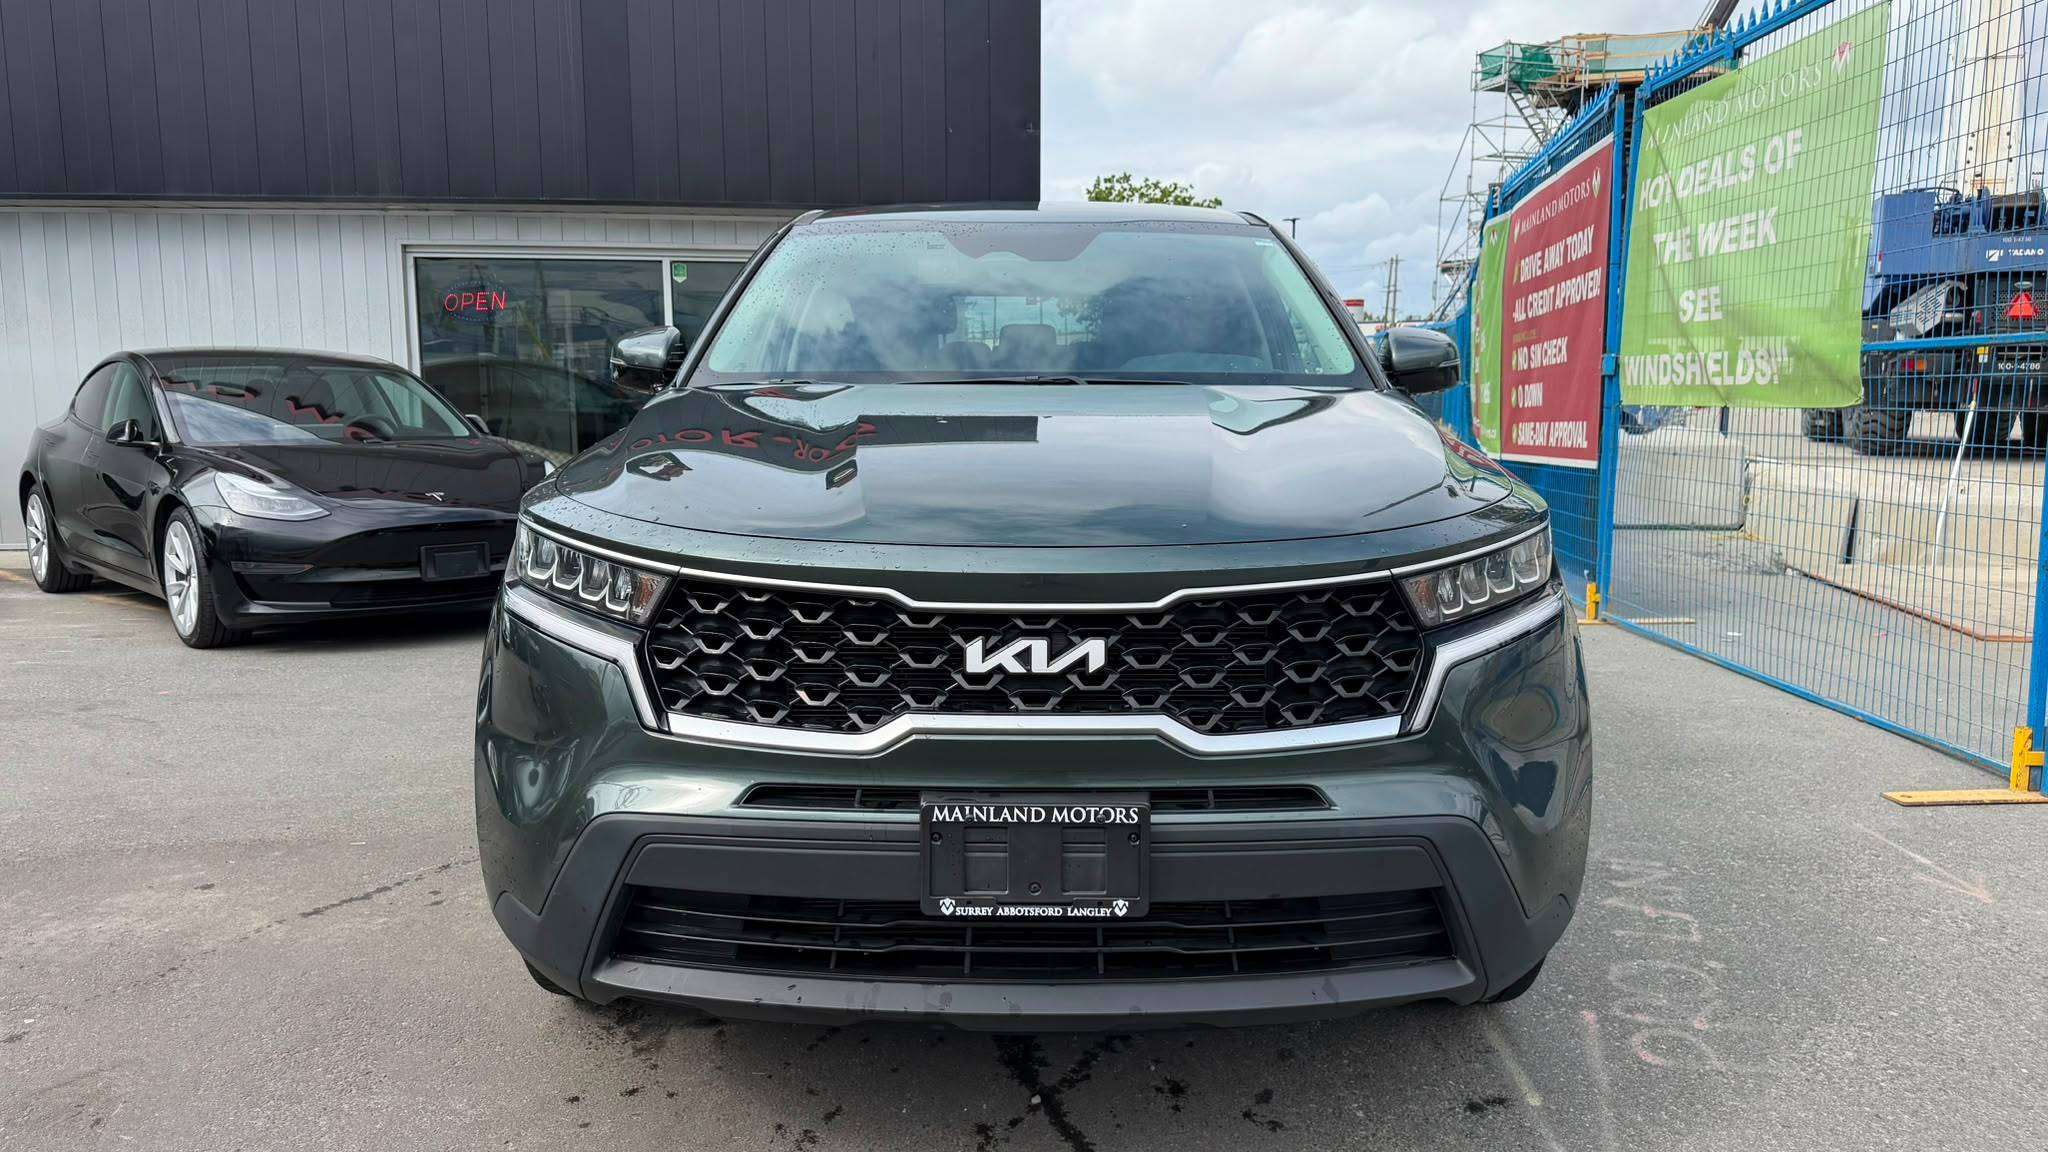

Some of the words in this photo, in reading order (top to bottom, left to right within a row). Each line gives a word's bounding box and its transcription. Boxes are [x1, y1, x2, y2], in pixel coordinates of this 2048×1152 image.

[1676, 143, 1756, 198] DEALS
[1764, 128, 1803, 175] OF
[1521, 199, 1557, 234] MAINLAND
[1558, 178, 1590, 213] MOTORS
[1520, 249, 1542, 283] DRIVE
[1543, 239, 1565, 273] AWAY
[1566, 224, 1594, 263] TODAY
[1653, 226, 1693, 266] THE
[1698, 207, 1778, 258] WEEK
[444, 290, 507, 313] OPEN
[1527, 286, 1555, 318] CREDIT
[1555, 267, 1601, 310] APPROVED!
[1679, 286, 1723, 323] SEE
[1517, 346, 1529, 371] NO
[1530, 343, 1542, 369] SIN
[1542, 336, 1568, 366] CHECK
[1524, 382, 1543, 407] DOWN
[1518, 421, 1549, 447] SAME-DAY
[1549, 420, 1588, 448] APPROVAL
[965, 636, 1106, 674] KIA
[931, 805, 1046, 824] MAINLAND
[1051, 806, 1139, 824] MOTORS
[955, 906, 994, 917] SURREY
[996, 906, 1063, 917] ABBOTSFORD
[1067, 907, 1112, 917] LANGLEY
